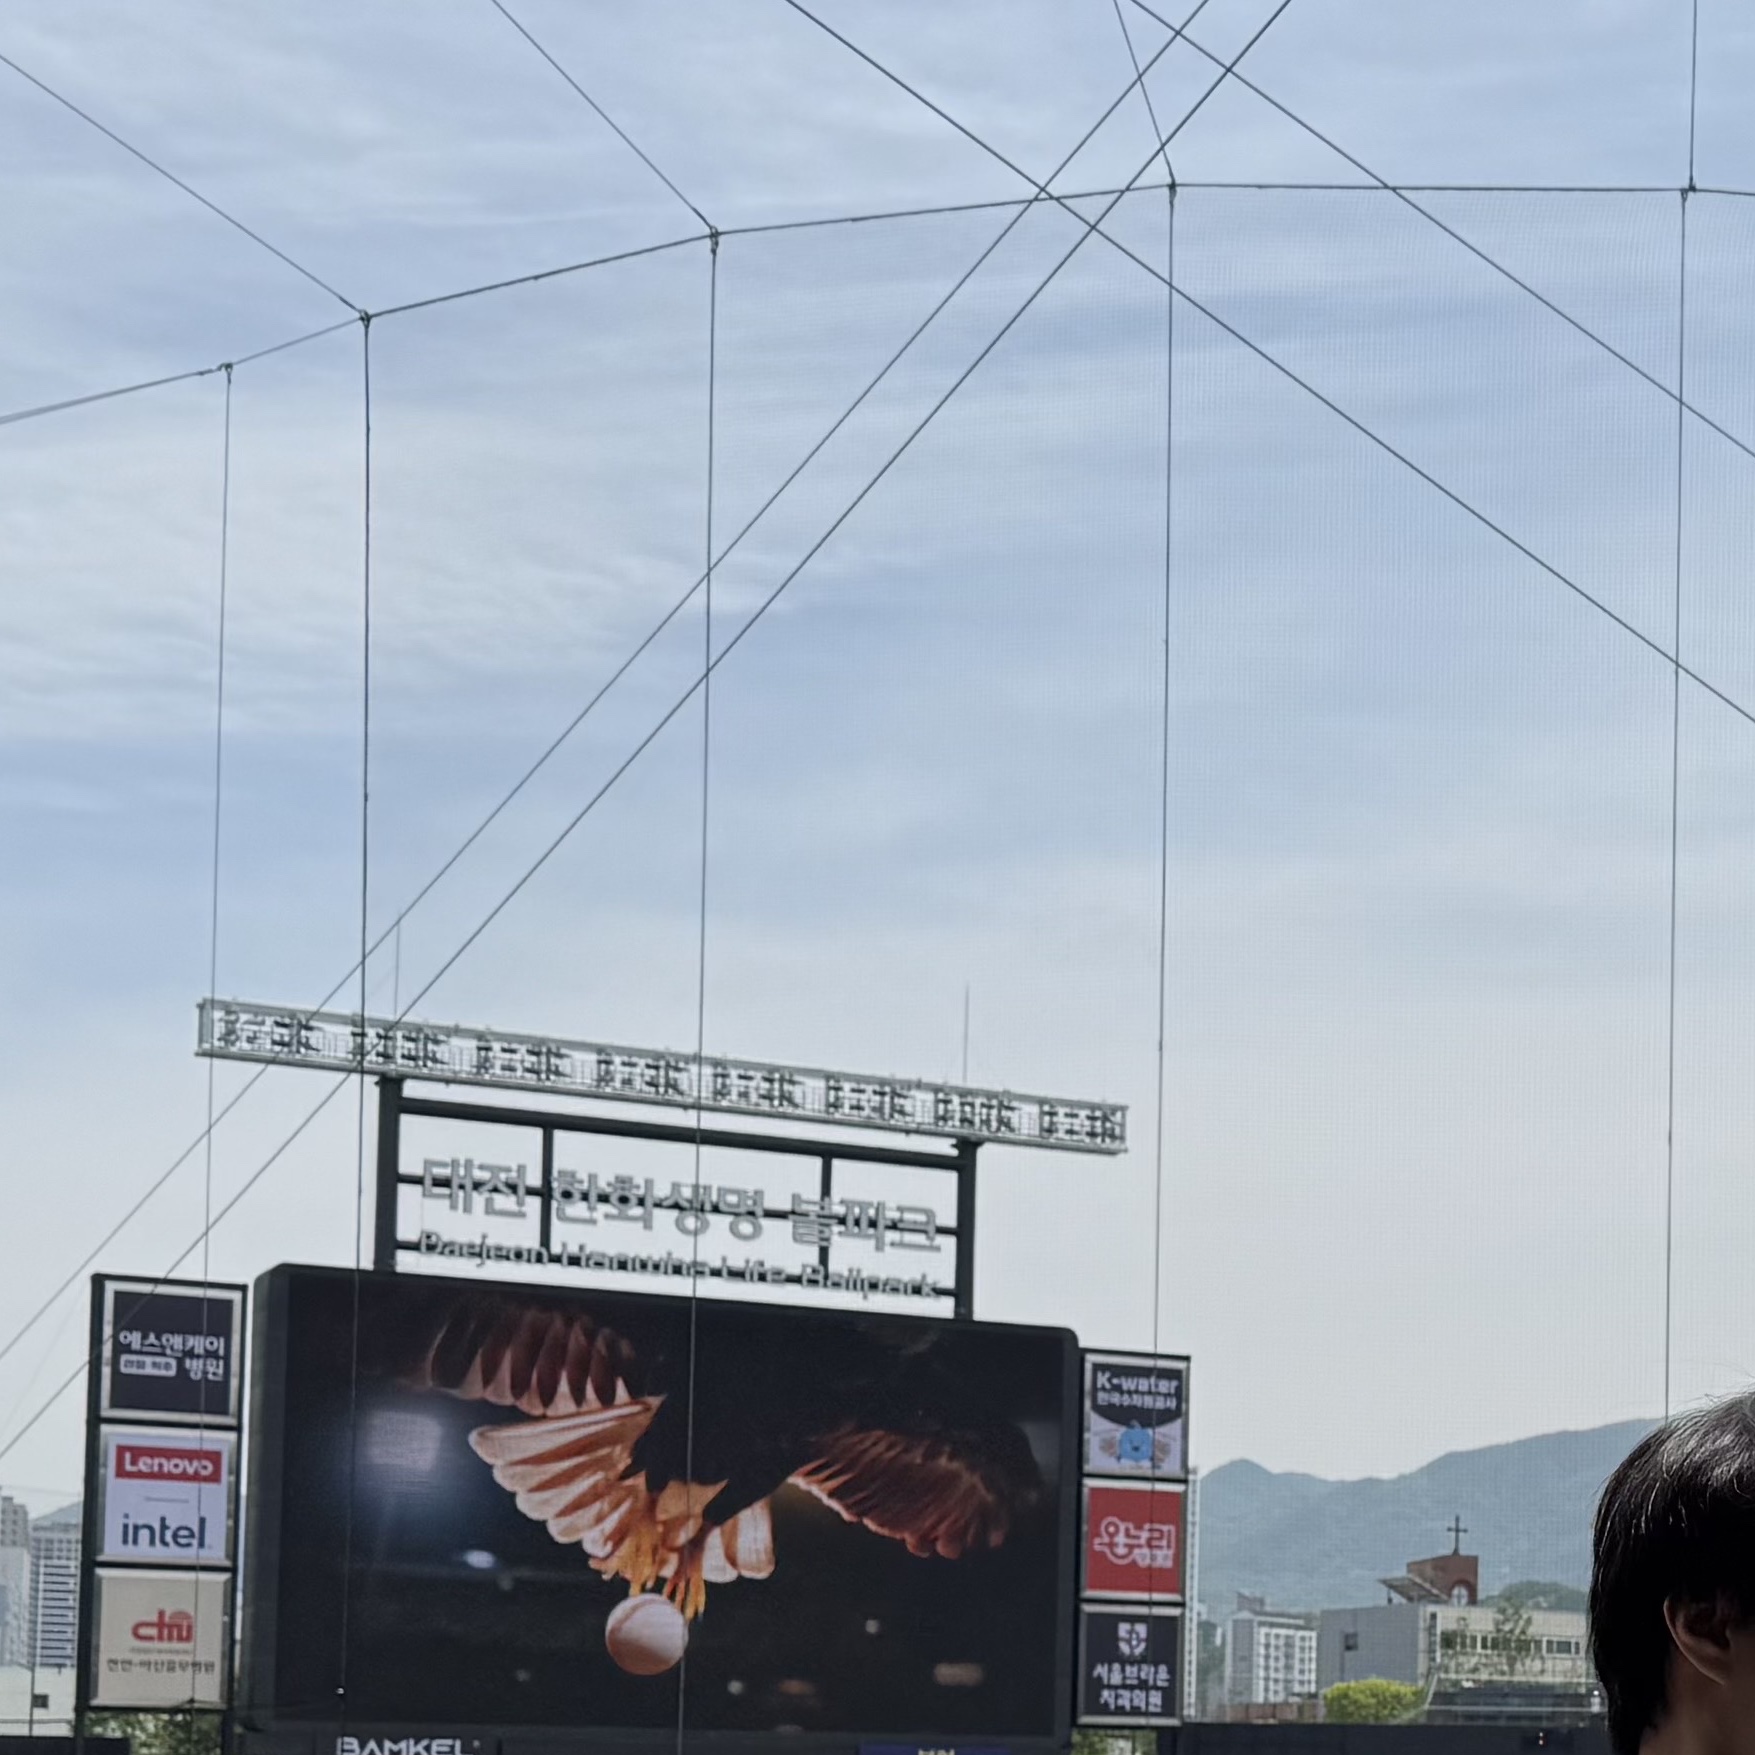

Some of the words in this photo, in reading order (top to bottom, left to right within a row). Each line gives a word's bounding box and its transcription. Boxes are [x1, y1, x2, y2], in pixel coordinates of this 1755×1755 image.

[422, 1158, 527, 1218] 대전
[553, 1168, 764, 1241] 한화생명
[788, 1192, 942, 1252] 볼파크
[419, 1230, 550, 1268] Daejeon
[560, 1241, 710, 1278] Hanwha
[680, 1255, 787, 1284] Life
[801, 1263, 941, 1301] Ballpark
[118, 1330, 225, 1357] 에스앤케이
[184, 1357, 225, 1381] 병원
[1096, 1370, 1179, 1395] K-water
[124, 1451, 215, 1477] Lenovo
[121, 1513, 208, 1549] intel
